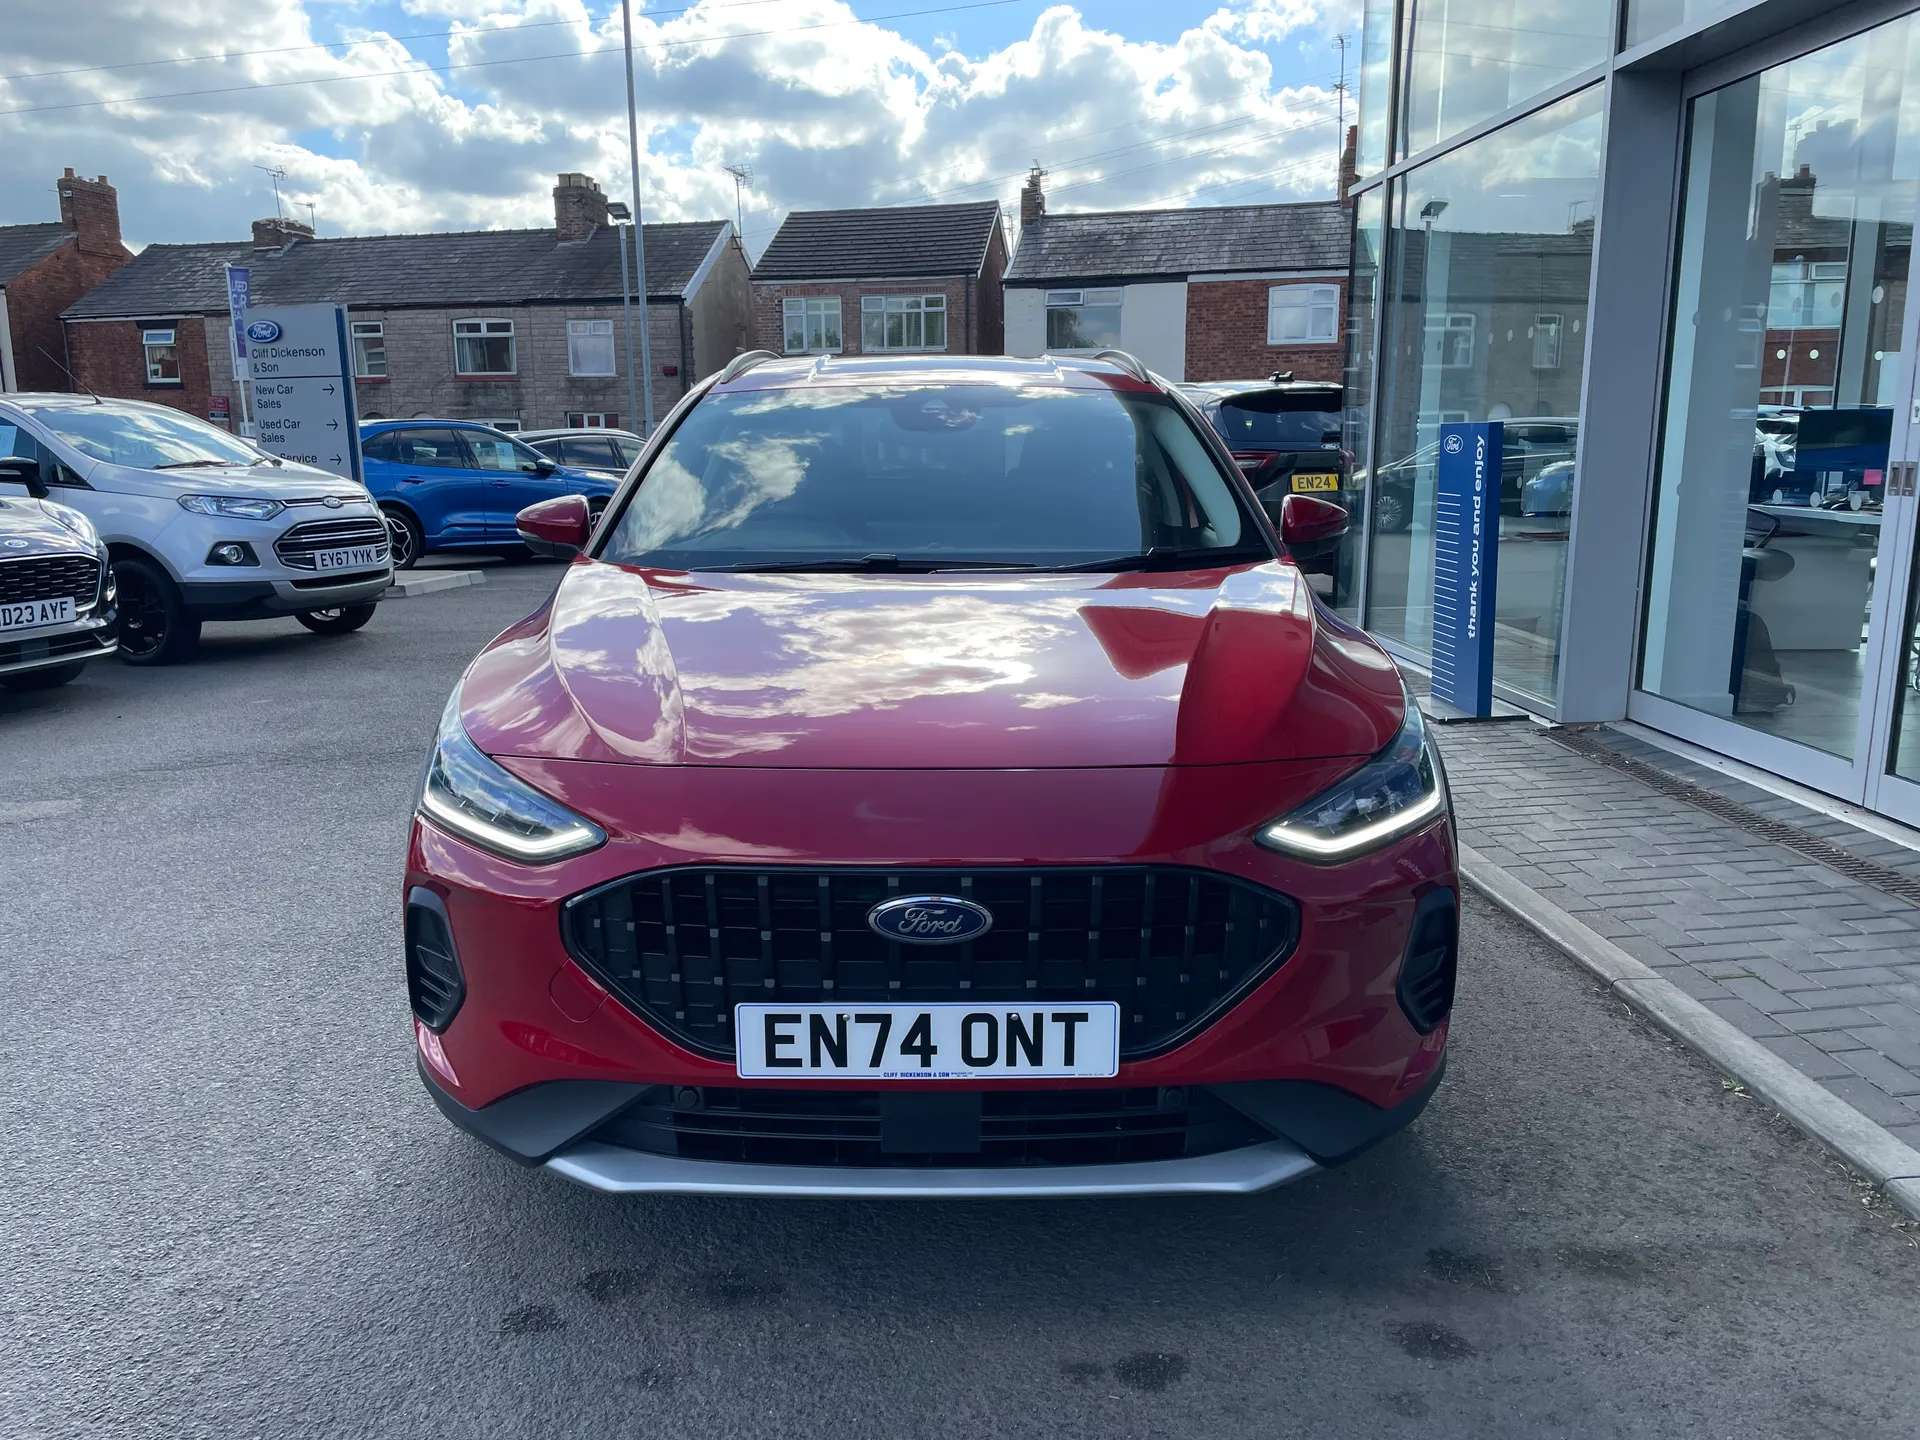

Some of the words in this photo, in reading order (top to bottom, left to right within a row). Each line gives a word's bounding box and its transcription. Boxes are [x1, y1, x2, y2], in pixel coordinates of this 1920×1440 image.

[252, 324, 273, 338] Ford
[251, 348, 269, 359] Cliff
[270, 347, 326, 359] Dickenson
[253, 364, 260, 373] &
[260, 362, 279, 373] Son
[255, 385, 275, 395] New
[276, 384, 294, 395] Car
[257, 399, 282, 409] Sales
[260, 419, 282, 430] Used
[283, 418, 301, 429] Car
[261, 433, 286, 443] Sales
[1446, 436, 1461, 451] Ford
[1474, 434, 1485, 492] enjoy
[1296, 475, 1331, 489] EN24
[1472, 496, 1481, 536] and
[320, 551, 349, 568] EY67
[351, 548, 373, 564] YYK
[1471, 540, 1480, 577] you
[0, 605, 35, 626] D23
[40, 601, 68, 621] AYF
[1467, 580, 1478, 639] thank
[898, 907, 964, 934] Ford
[764, 1013, 938, 1068] EN74
[960, 1012, 1088, 1067] ONT
